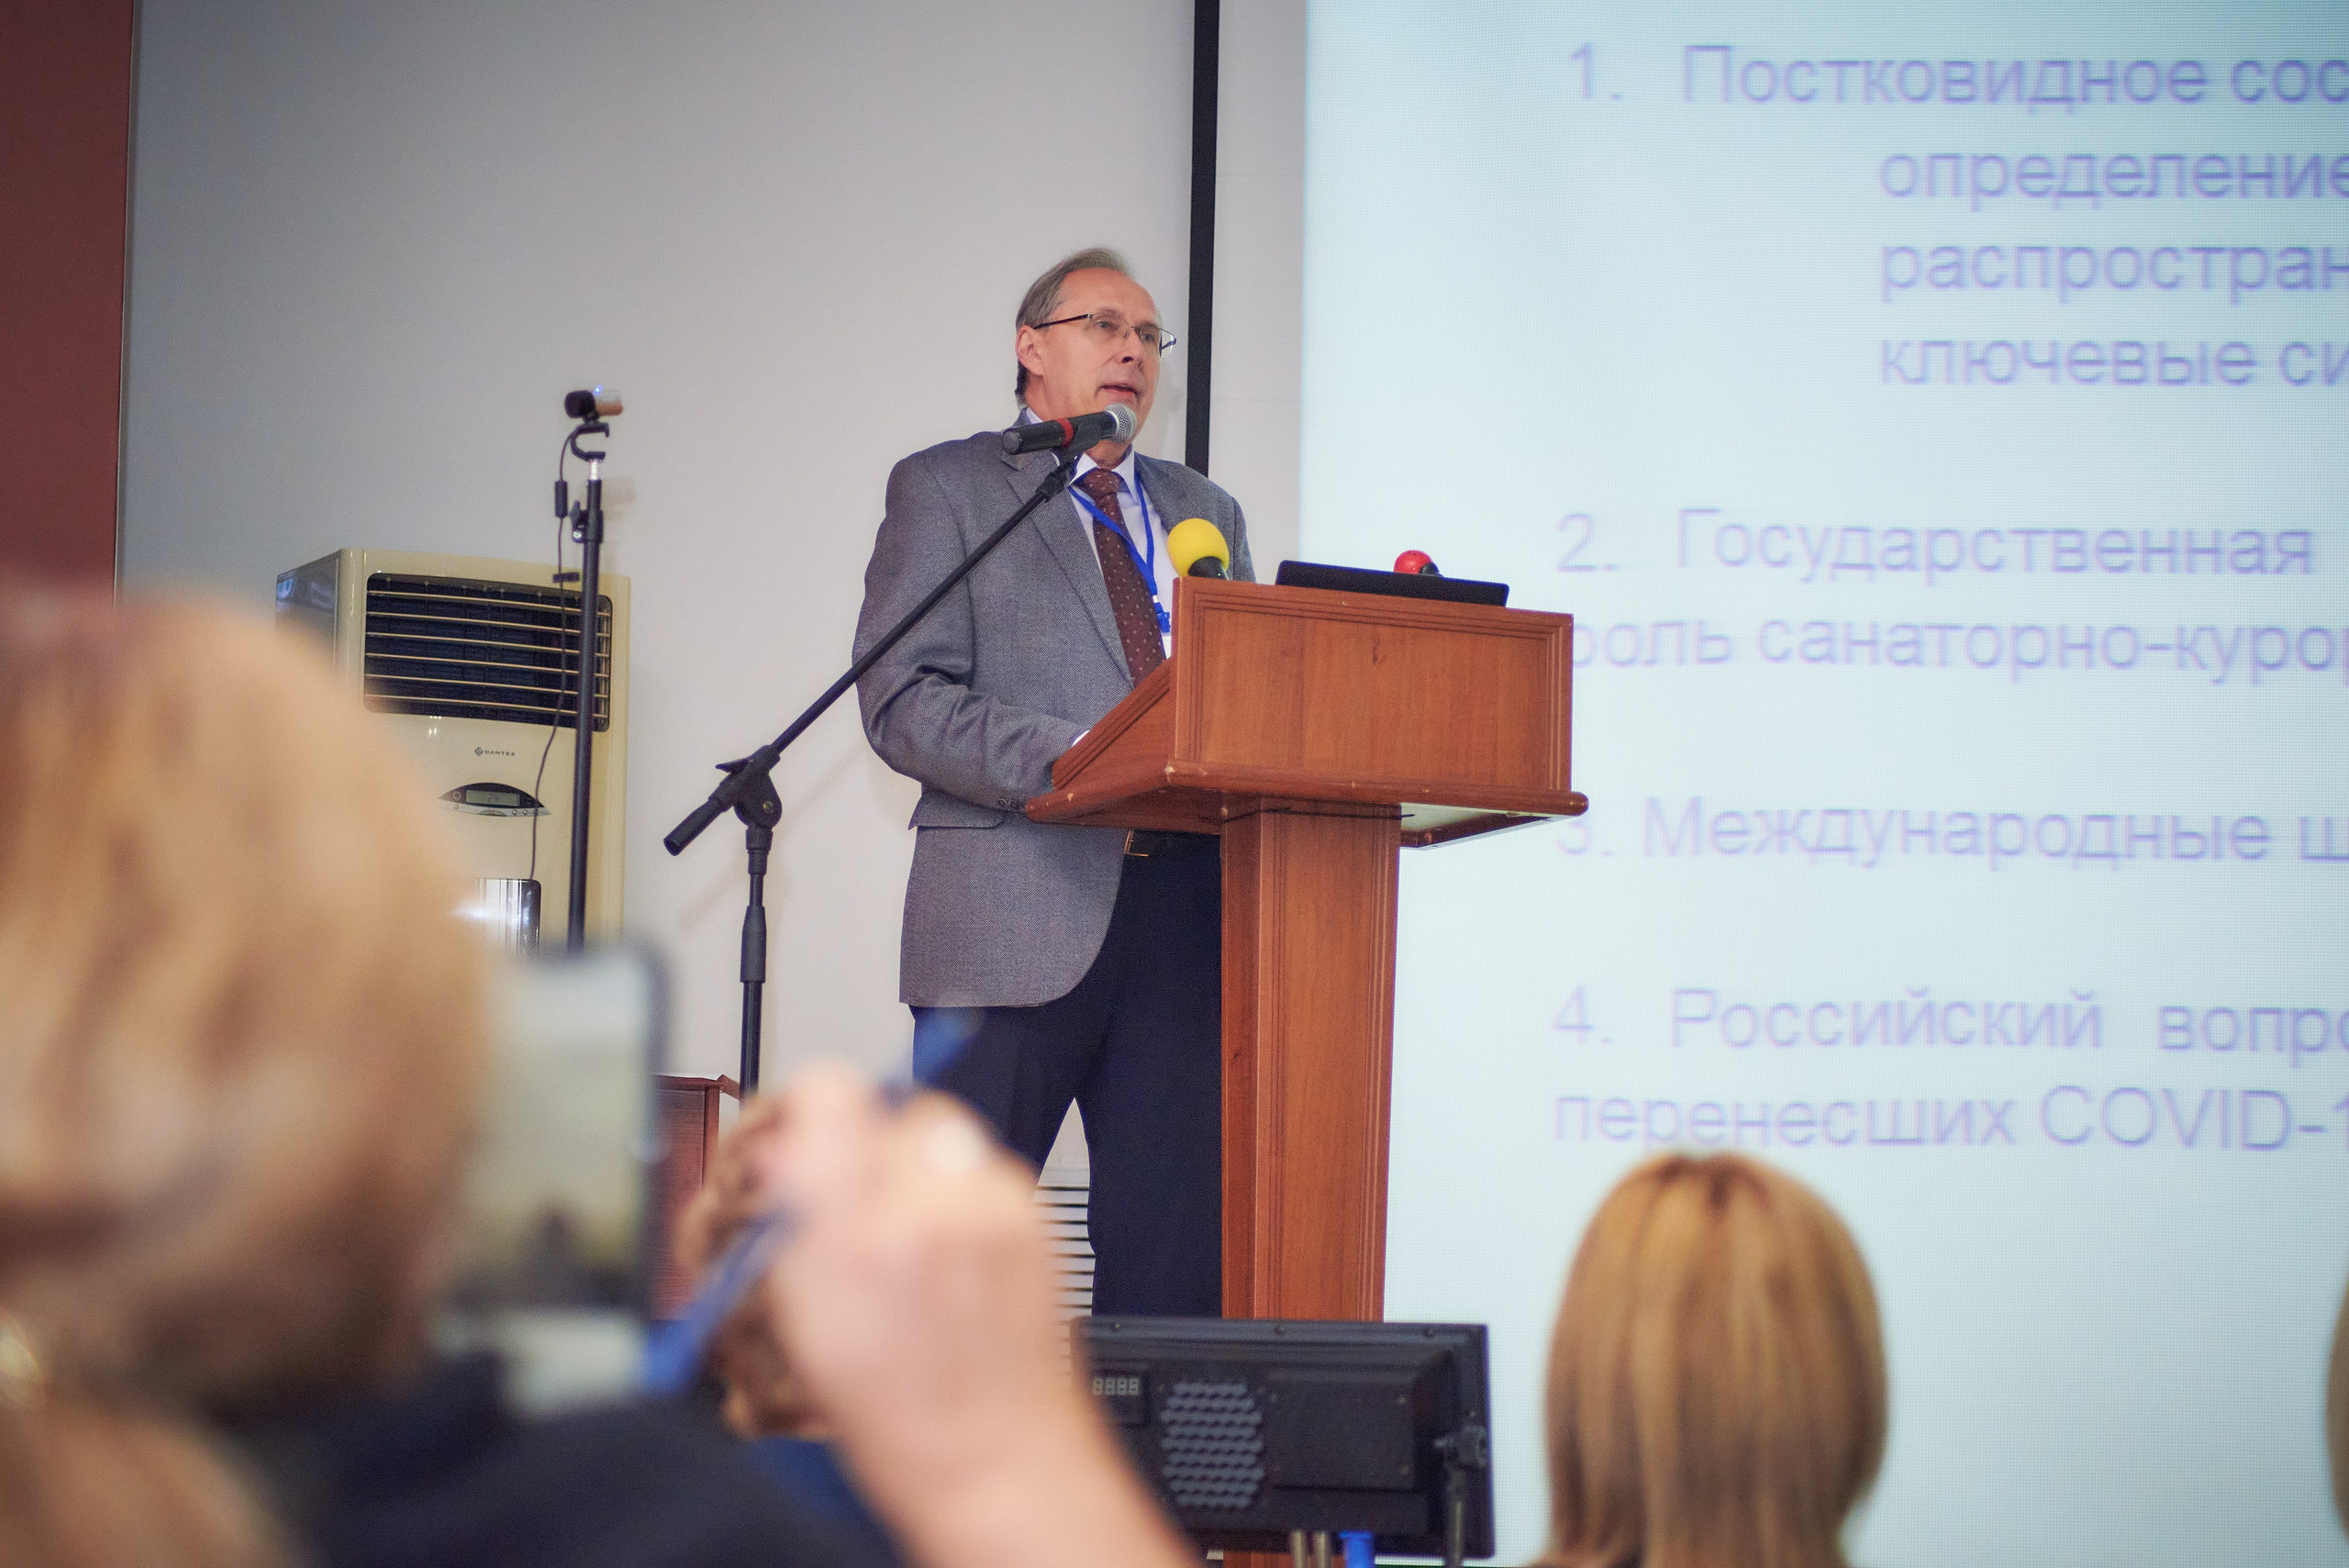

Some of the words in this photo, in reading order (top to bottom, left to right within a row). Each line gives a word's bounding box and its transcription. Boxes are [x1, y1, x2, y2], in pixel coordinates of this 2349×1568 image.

[1570, 42, 1622, 101] 1.
[1683, 44, 2211, 114] Постковидное
[1880, 245, 2349, 305] распростран
[1879, 339, 2257, 388] ключевые
[1557, 512, 1617, 573] 2.
[1678, 507, 2316, 585] Государственная
[1756, 618, 2349, 685] санаторно-куро
[1643, 795, 2272, 872] Международные
[1553, 985, 1612, 1044] 4.
[1671, 986, 2102, 1049] Российский
[2158, 1006, 2349, 1069] вопр
[1554, 1095, 2017, 1150] перенесших
